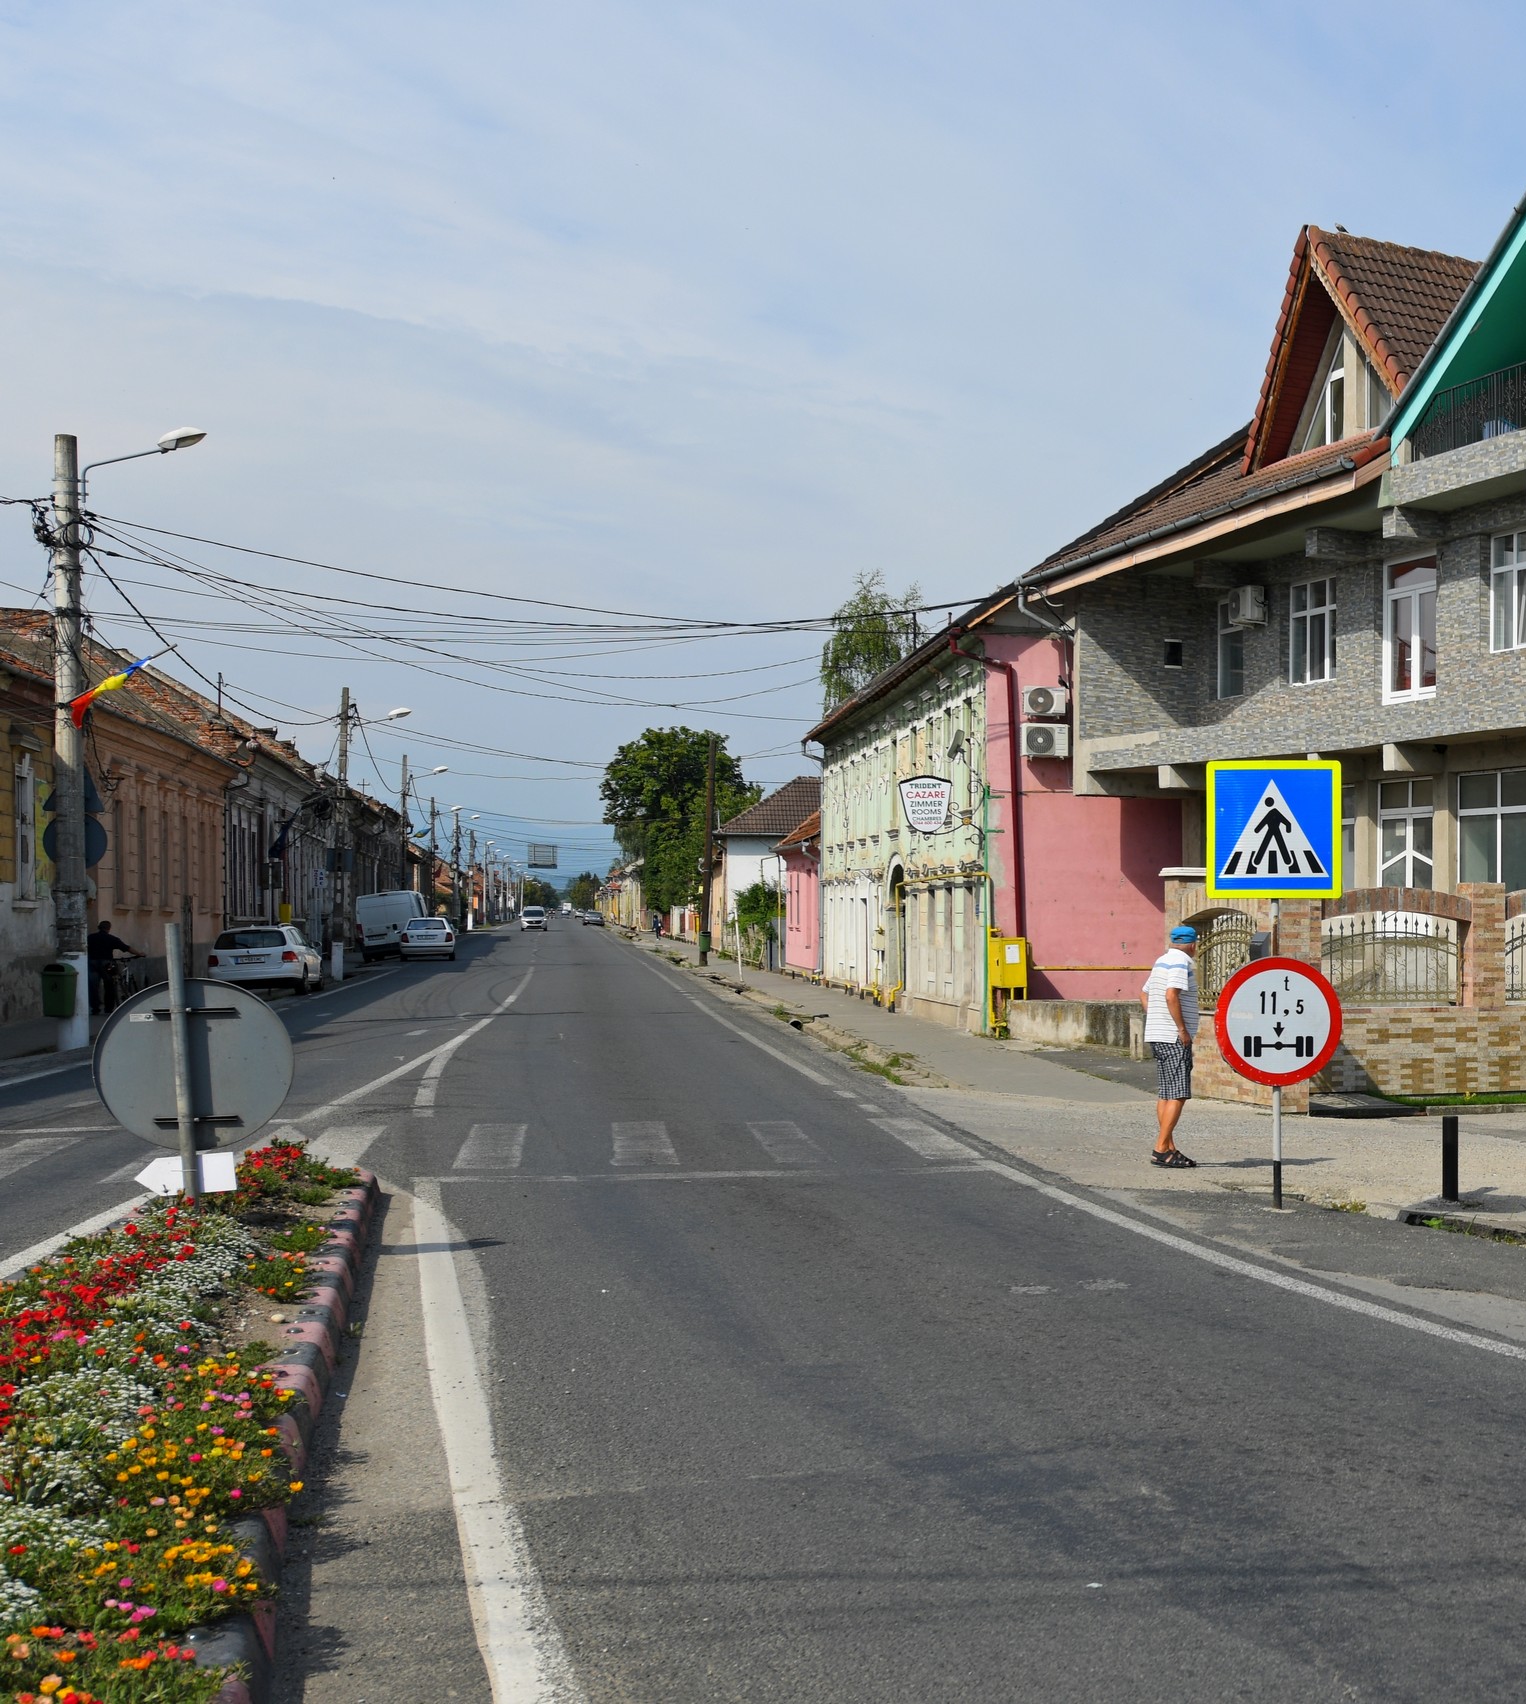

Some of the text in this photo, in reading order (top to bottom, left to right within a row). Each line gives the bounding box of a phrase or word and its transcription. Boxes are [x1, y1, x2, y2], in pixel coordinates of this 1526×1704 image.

[906, 791, 946, 799] CAZARE
[1283, 975, 1290, 991] t
[1260, 991, 1304, 1016] 11,5
